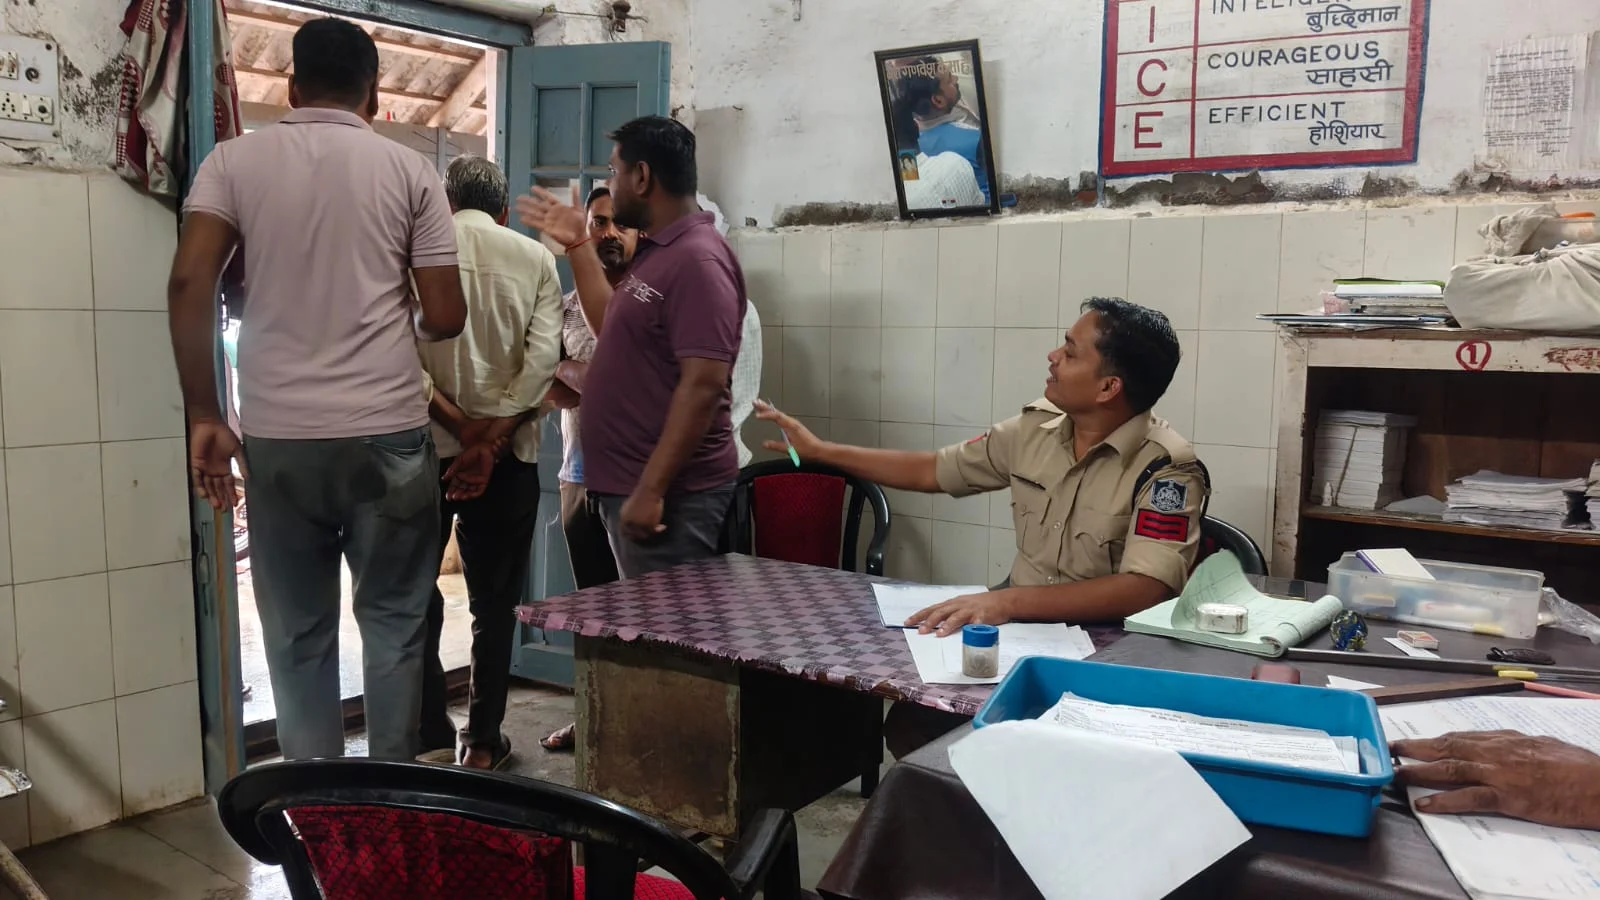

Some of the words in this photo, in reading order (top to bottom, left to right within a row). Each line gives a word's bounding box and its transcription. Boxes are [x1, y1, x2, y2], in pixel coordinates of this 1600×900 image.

[1149, 6, 1155, 44] I
[1207, 40, 1380, 69] COURAGEOUS
[1136, 58, 1168, 97] C
[1305, 59, 1393, 87] साहसी
[1209, 101, 1346, 124] EFFICIENT
[1133, 110, 1164, 149] E
[1308, 120, 1386, 145] होशियार
